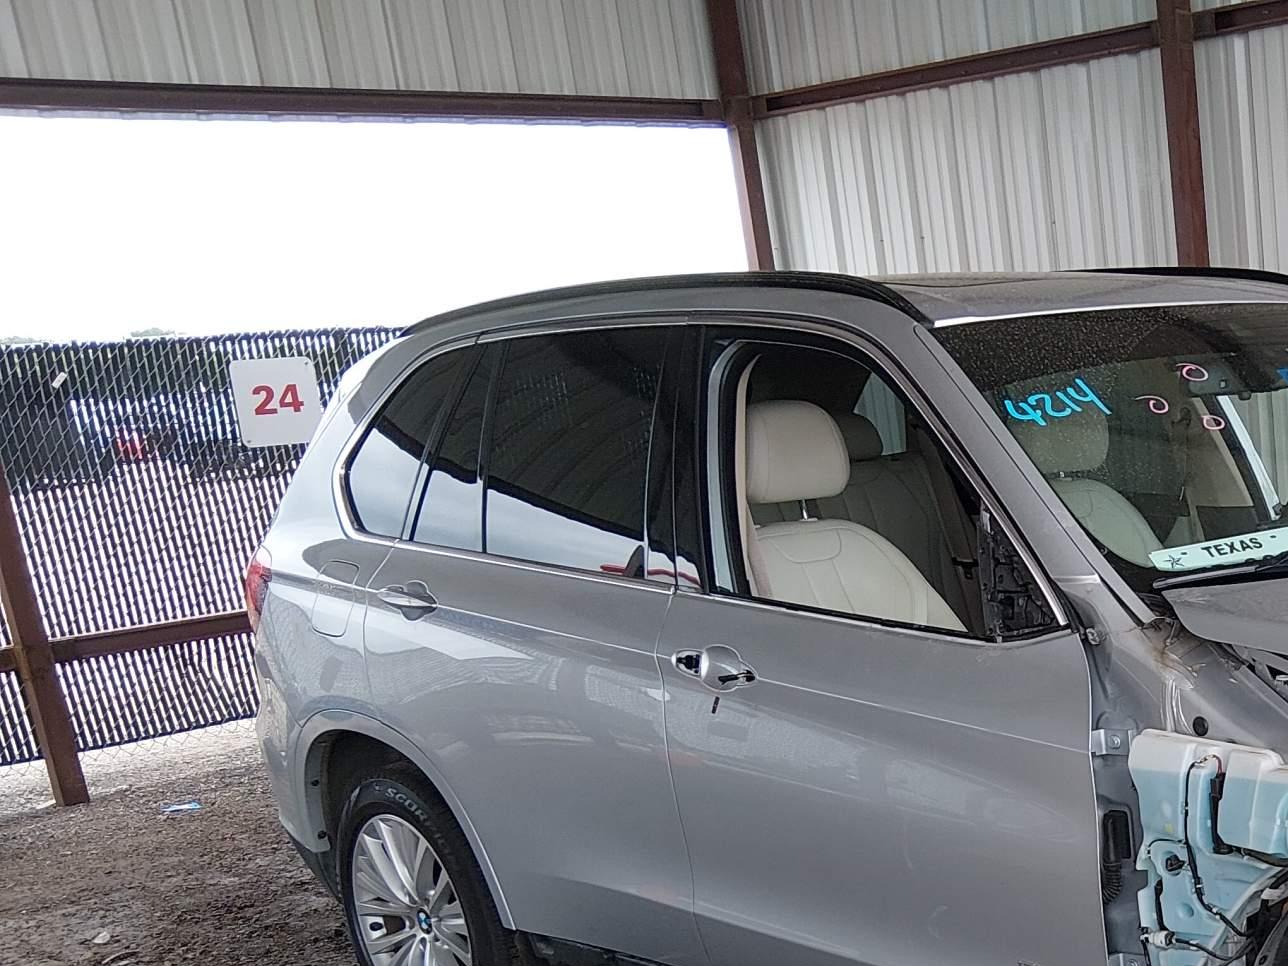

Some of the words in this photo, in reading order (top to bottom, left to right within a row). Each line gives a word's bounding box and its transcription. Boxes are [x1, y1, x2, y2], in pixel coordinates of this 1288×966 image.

[252, 384, 304, 415] 24
[1004, 378, 1112, 426] 4214
[1201, 537, 1263, 558] TEXAS
